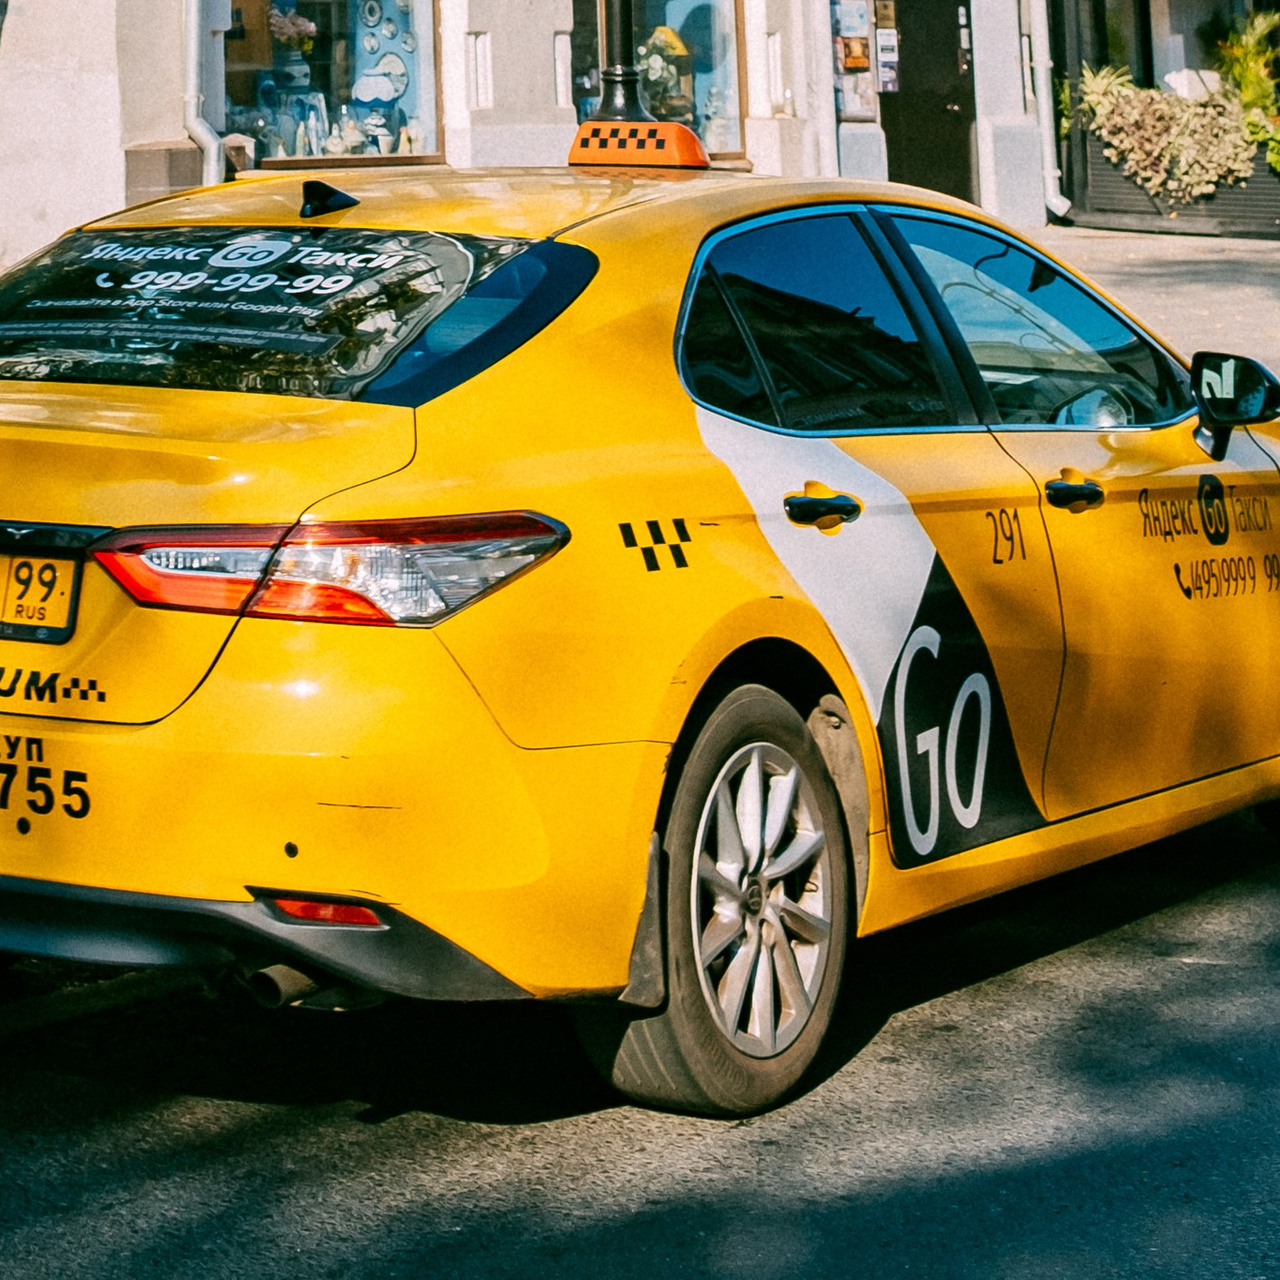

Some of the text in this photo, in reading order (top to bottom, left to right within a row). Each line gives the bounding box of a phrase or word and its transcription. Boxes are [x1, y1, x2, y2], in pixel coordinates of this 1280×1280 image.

[81, 243, 405, 269] Яндекс Go Такси
[121, 271, 354, 294] 999-99-99
[120, 298, 155, 308] App
[155, 298, 198, 308] Store
[198, 301, 231, 310] или
[231, 301, 289, 314] Google
[288, 305, 324, 318] Play
[1138, 487, 1199, 543] Яндекс
[1227, 484, 1273, 532] Такси
[985, 508, 1027, 564] 291
[14, 560, 58, 603] 99
[14, 603, 47, 621] RUS
[894, 625, 991, 856] Go
